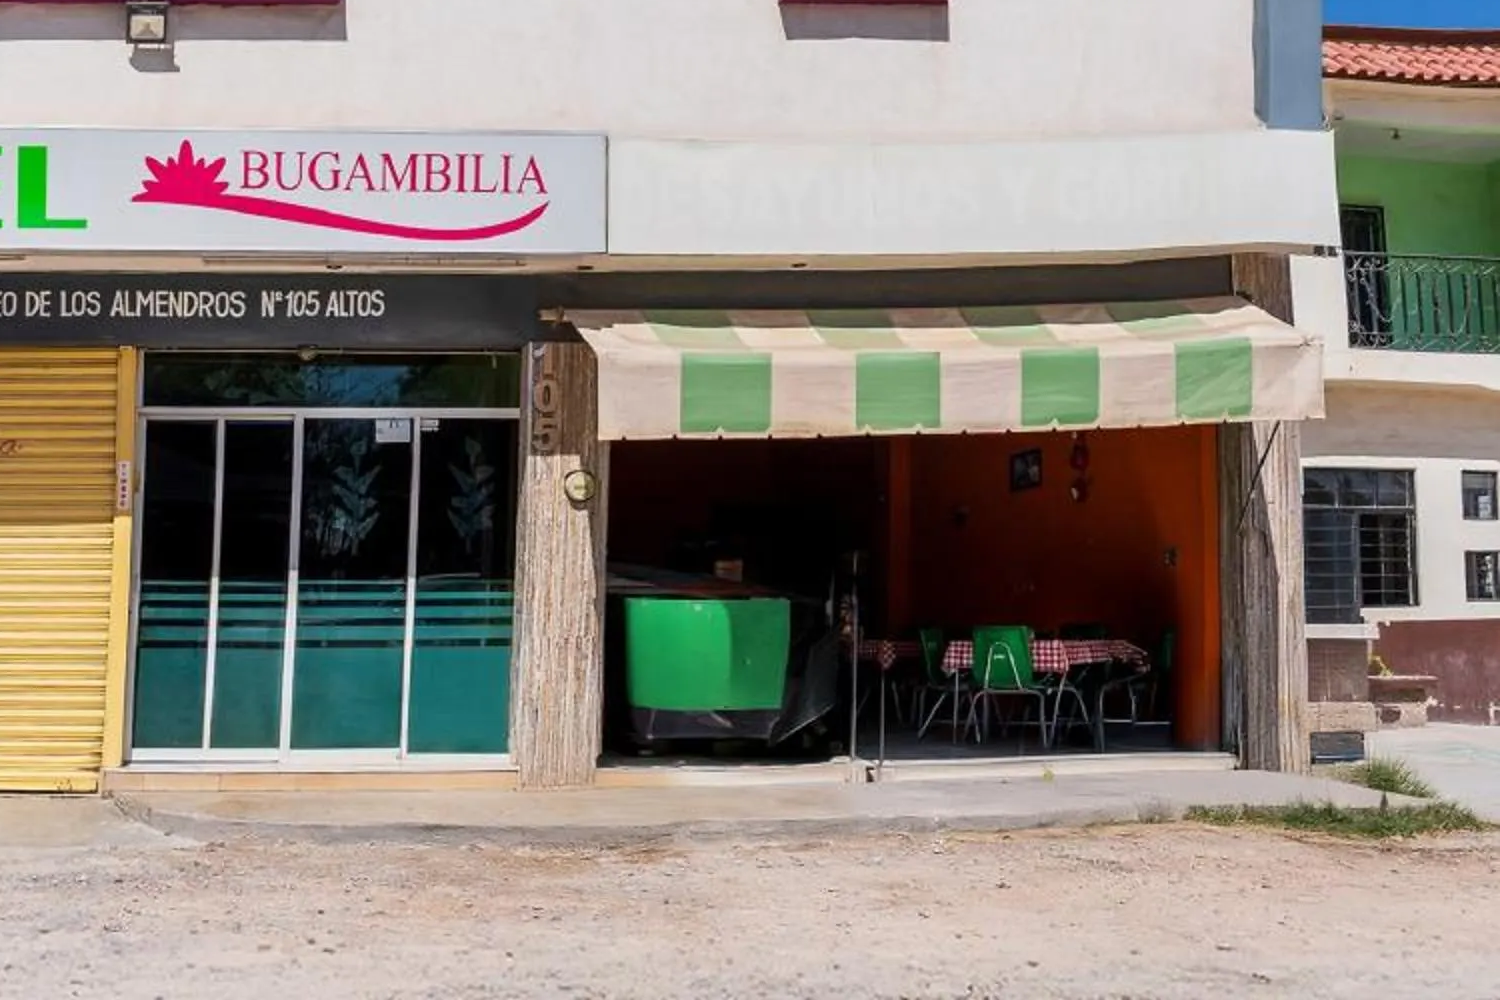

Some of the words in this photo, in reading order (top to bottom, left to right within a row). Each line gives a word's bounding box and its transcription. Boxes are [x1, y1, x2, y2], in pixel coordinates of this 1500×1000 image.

[239, 150, 549, 195] BUGAMBILIA
[24, 290, 52, 318] DE
[59, 290, 101, 318] LOS
[109, 290, 246, 318] ALMENDROS
[325, 289, 385, 318] ALTOS
